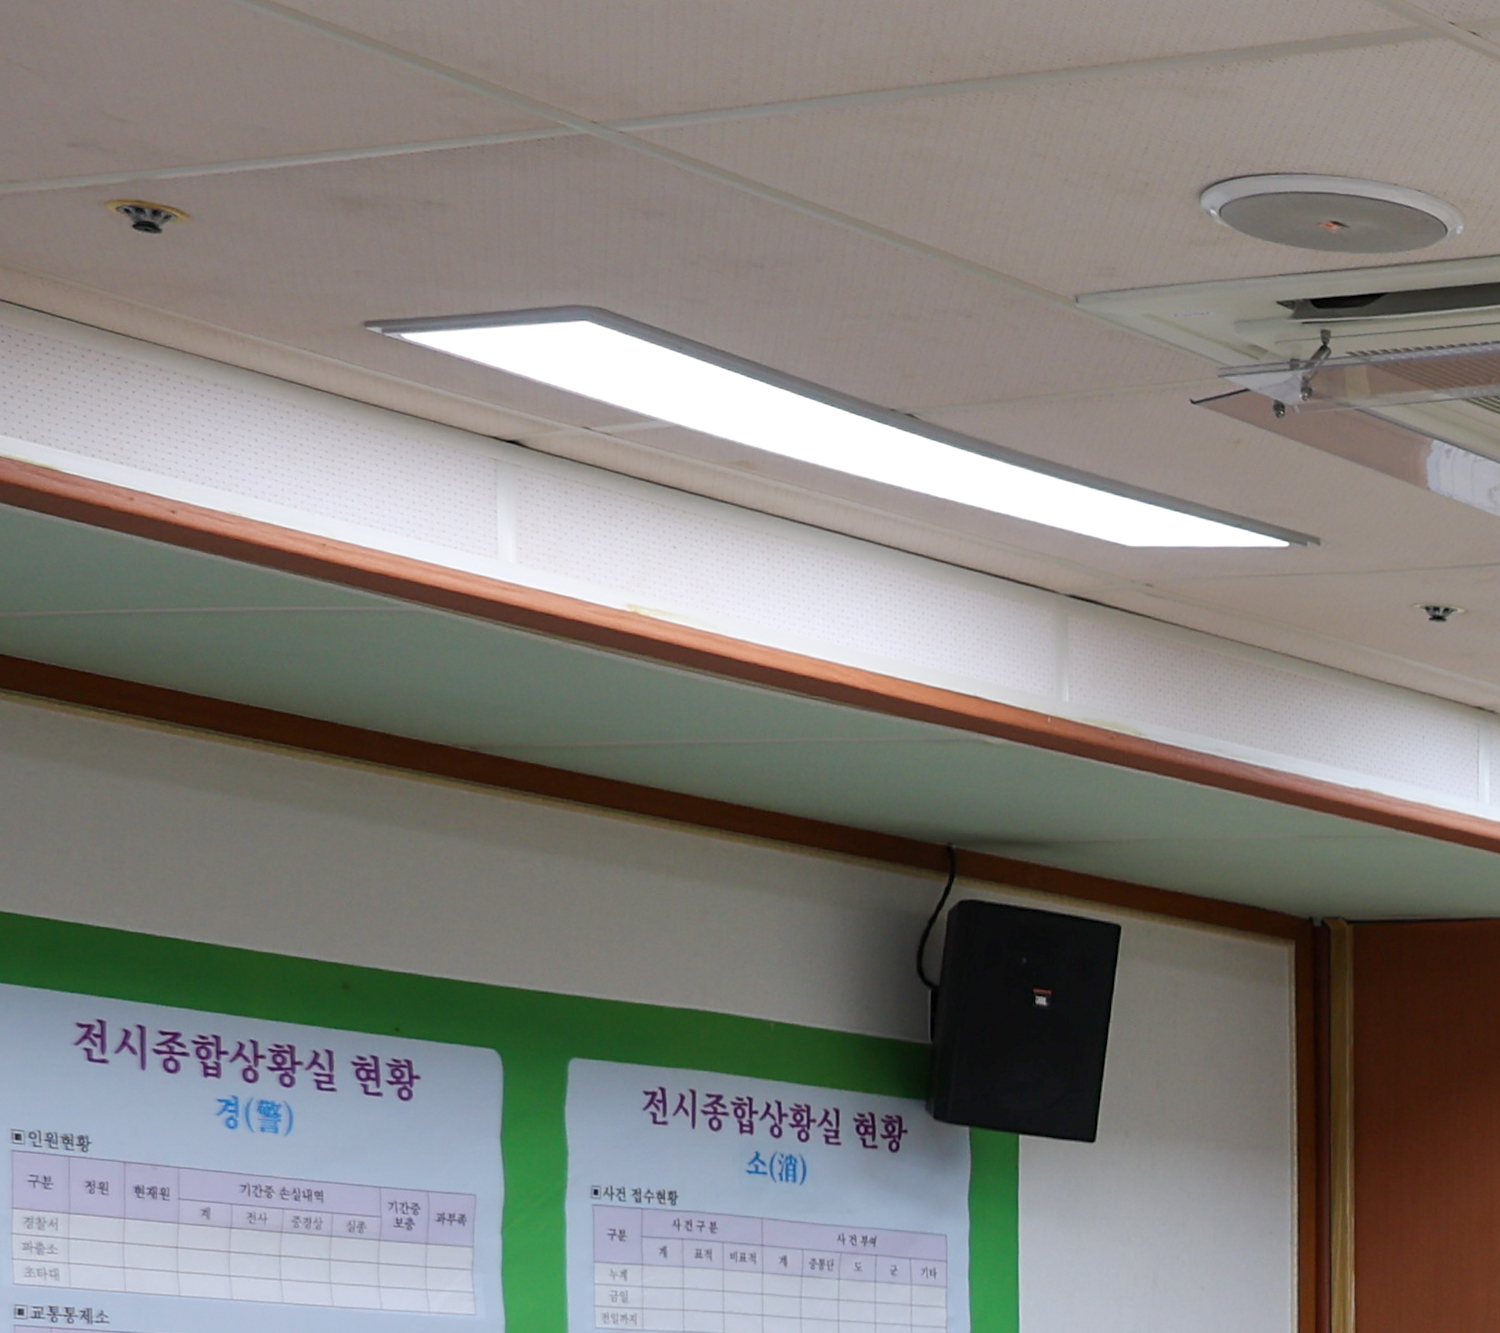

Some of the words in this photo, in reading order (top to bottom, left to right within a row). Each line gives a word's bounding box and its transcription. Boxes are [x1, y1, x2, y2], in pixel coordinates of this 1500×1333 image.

[73, 1018, 337, 1093] 전시종합상황실
[351, 1054, 421, 1102] 현황
[216, 1095, 294, 1136] 경(警)
[642, 1087, 842, 1146] 전시종합상황실
[853, 1112, 908, 1153] 현황
[28, 1130, 92, 1153] 인원현황
[746, 1151, 807, 1185] 소(消)
[28, 1174, 54, 1191] 구분
[84, 1180, 110, 1196] 정원
[134, 1184, 171, 1201] 현재원
[240, 1183, 275, 1199] 기간중
[279, 1186, 325, 1203] 손실내역
[603, 1186, 626, 1201] 사건
[632, 1188, 678, 1206] 접수현황
[201, 1207, 211, 1220] 계
[388, 1201, 421, 1216] 기간중
[22, 1216, 60, 1231] 경찰서
[247, 1211, 268, 1226] 전사
[607, 1229, 627, 1242] 구분
[22, 1242, 58, 1256] 파출소
[609, 1268, 628, 1281] 누계
[854, 1262, 863, 1272] 도
[920, 1267, 937, 1279] 기타
[609, 1290, 629, 1303] 금일
[30, 1305, 110, 1325] 교통통제소
